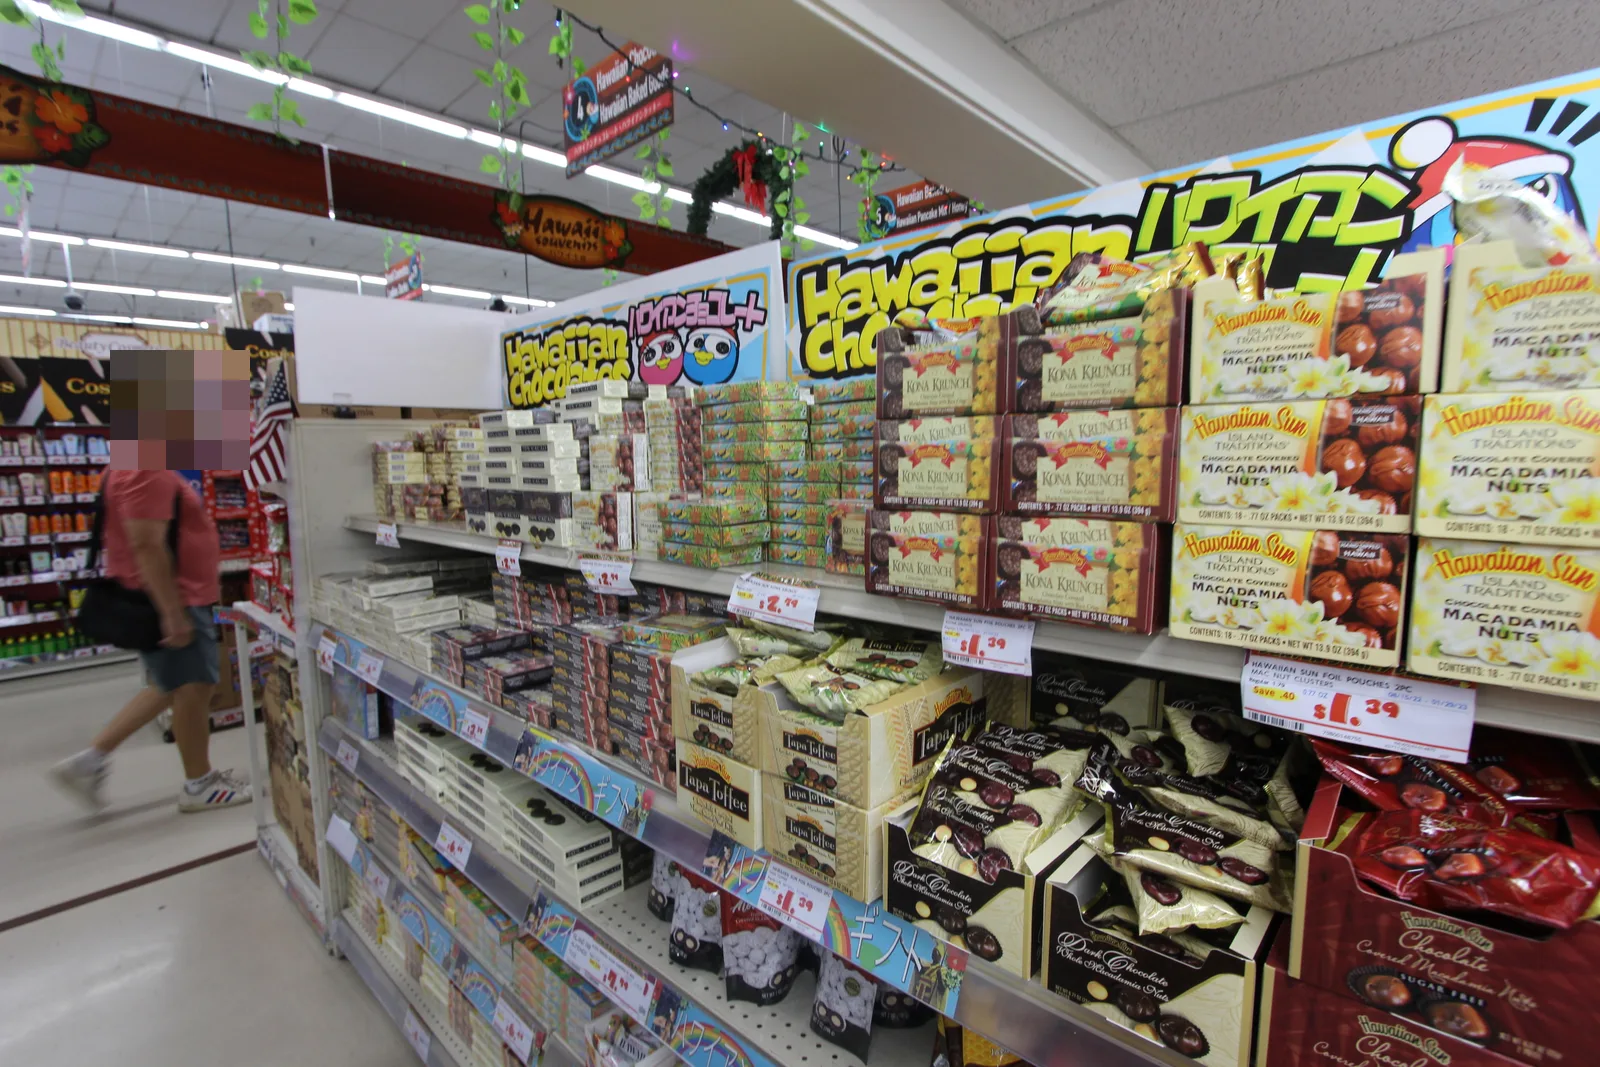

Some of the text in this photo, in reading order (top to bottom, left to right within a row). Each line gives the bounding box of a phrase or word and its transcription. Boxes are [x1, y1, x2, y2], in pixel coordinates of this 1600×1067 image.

[596, 60, 628, 92] Hawaiian
[577, 96, 584, 121] 4
[600, 94, 628, 124] Hawaiian
[628, 81, 649, 108] Baked
[896, 189, 924, 207] Hawaiian
[1135, 170, 1412, 251] ハワイアン
[522, 207, 600, 239] Hawaii
[917, 209, 938, 223] Pancake
[535, 236, 598, 252] souvenirs
[803, 223, 1134, 330] Hawaiian
[1483, 270, 1594, 312] Hawaiian
[1215, 300, 1324, 336] Hawaiian Sun
[504, 320, 629, 374] Hawaiian
[1221, 352, 1315, 366] MACADAMIA
[1527, 346, 1588, 359] NUTS
[1047, 363, 1132, 384] KONA KRUNCH
[1246, 365, 1288, 376] NUTS
[906, 378, 970, 394] KONA KRUNCH
[1078, 417, 1128, 437] KRUNCH
[1193, 406, 1308, 440] Hawaiian Sun
[1441, 395, 1556, 437] Hawaiian
[929, 423, 966, 441] KRUNCH
[1227, 431, 1274, 441] ISLAND
[902, 469, 964, 484] KONA KRUNCH
[1042, 471, 1124, 488] KONA KRUNCH
[1201, 463, 1300, 475] MACADAMIA
[1226, 476, 1270, 487] NUTS
[1450, 466, 1593, 478] MACADAMIA
[1487, 480, 1551, 493] NUTS
[1270, 512, 1293, 522] PACKS
[1060, 528, 1108, 545] KRUNCH
[1184, 530, 1298, 565] Hawaiian Sun
[892, 560, 953, 578] KONA KRUNCH
[1205, 562, 1275, 575] TRADITIONS
[1218, 554, 1264, 566] ISLAND
[1433, 546, 1597, 592] Hawaiian Sun
[1025, 573, 1104, 595] KONA KRUNCH
[1192, 582, 1288, 600] MACADAMIA
[1193, 573, 1288, 588] CHOCOLATE COVERED
[1482, 575, 1548, 590] ISLAND
[1217, 596, 1260, 610] NUTS
[1444, 598, 1582, 618] CHOCOLATE COVERED
[1443, 608, 1582, 633] MACADAMIA
[960, 634, 1006, 657] $1.39
[1189, 626, 1223, 638] CONTENTS:
[1249, 634, 1259, 643] OZ
[1259, 635, 1281, 646] PACKS
[1287, 639, 1301, 649] NET
[1302, 641, 1314, 651] WT
[1331, 645, 1341, 655] OZ
[1478, 626, 1540, 643] NUTS
[1251, 661, 1296, 674] HAWAIIAN
[1300, 668, 1319, 678] SUN
[1322, 672, 1341, 682] FOIL
[1346, 676, 1390, 689] POUCHES
[1251, 669, 1334, 688] MAC NUT CLUSTERS
[1437, 661, 1486, 676] CONTENTS:
[1538, 674, 1570, 688] PACKS
[1253, 685, 1296, 701] Save .40
[692, 703, 732, 726] Tapa Toffee
[1313, 692, 1400, 727] $1.39
[916, 704, 985, 760] Tapa Toffee
[784, 732, 836, 761] Tapa Toffee
[985, 758, 1030, 785] Chocolate
[528, 747, 630, 823] ハワイアン ギフト
[681, 764, 747, 813] Tapa Toffee
[1436, 777, 1463, 799] FREE
[954, 797, 996, 823] Chocolate
[788, 817, 836, 850] Tapa Toffee
[1145, 820, 1200, 843] Macadamia
[1163, 812, 1224, 839] Chocolate
[894, 860, 972, 903] Dark Chocolate
[776, 889, 814, 915] $1.39
[912, 883, 954, 907] Macadamia
[954, 901, 973, 916] Nuts
[850, 903, 922, 983] ギフト
[1401, 911, 1494, 952] Hawaiian Sun
[1058, 932, 1168, 987] Dark Chocolate
[1399, 929, 1489, 972] Chocolate
[1056, 945, 1169, 1002] Whole Macadamia Nuts
[1356, 940, 1496, 996] Covered Macadamia
[1400, 973, 1486, 1007] SUGAR FREE
[1357, 1015, 1452, 1066] Hawaiian Sun
